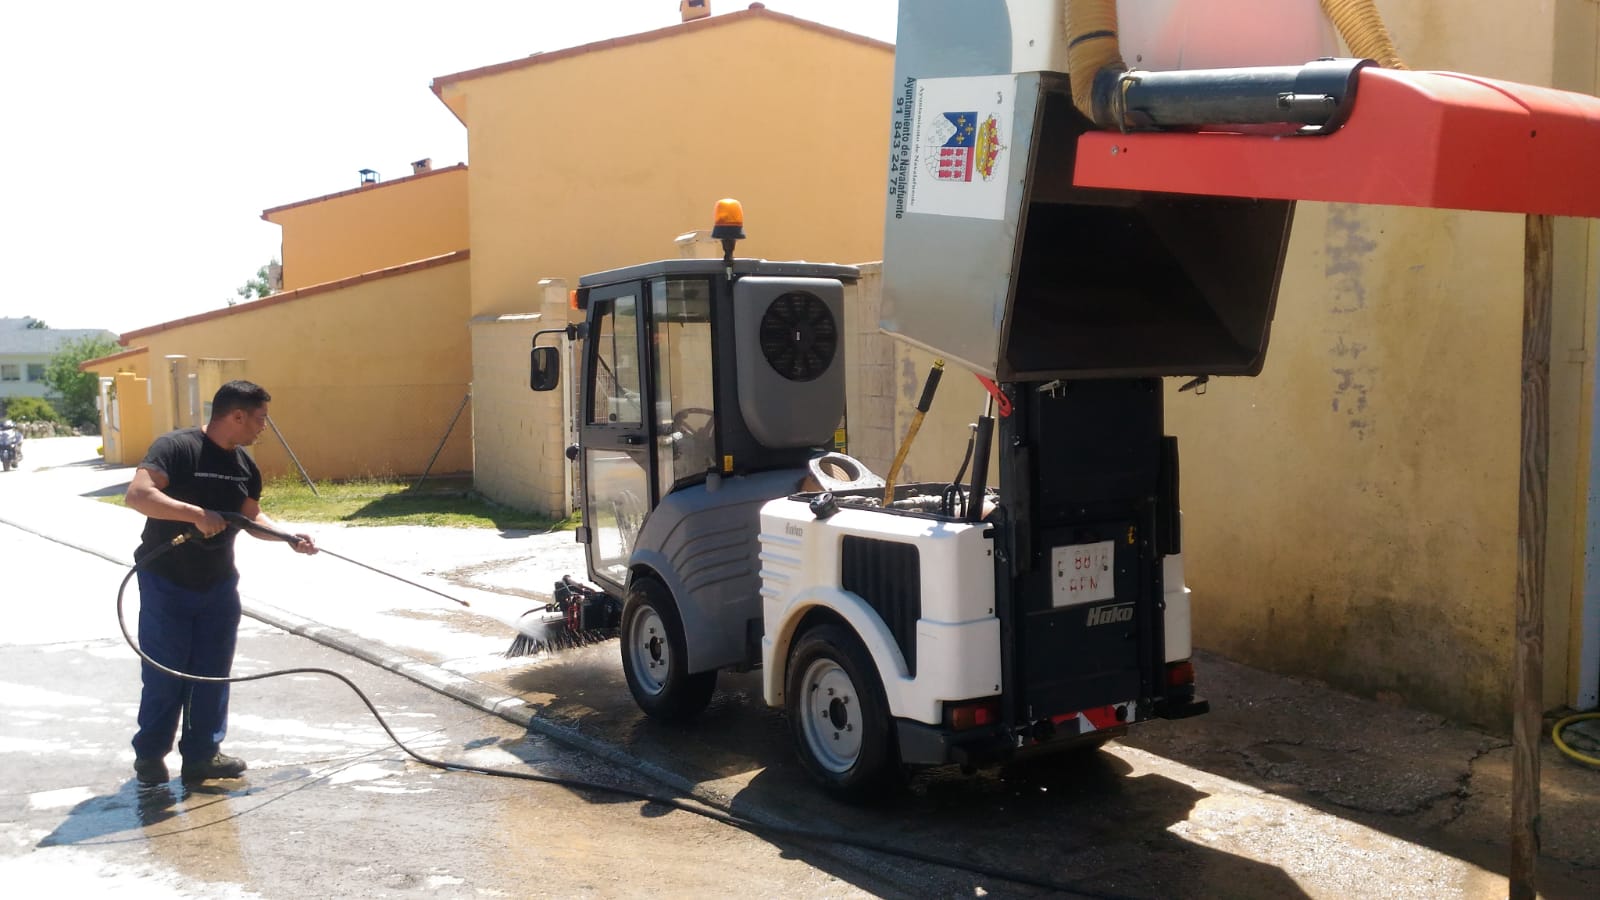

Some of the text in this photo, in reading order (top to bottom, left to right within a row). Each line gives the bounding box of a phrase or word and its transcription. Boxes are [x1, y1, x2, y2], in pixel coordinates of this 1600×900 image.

[889, 97, 904, 195] 91 843 24 75
[896, 77, 916, 219] Ayuntamiento de Navalafuente
[1086, 606, 1133, 627] Hako
